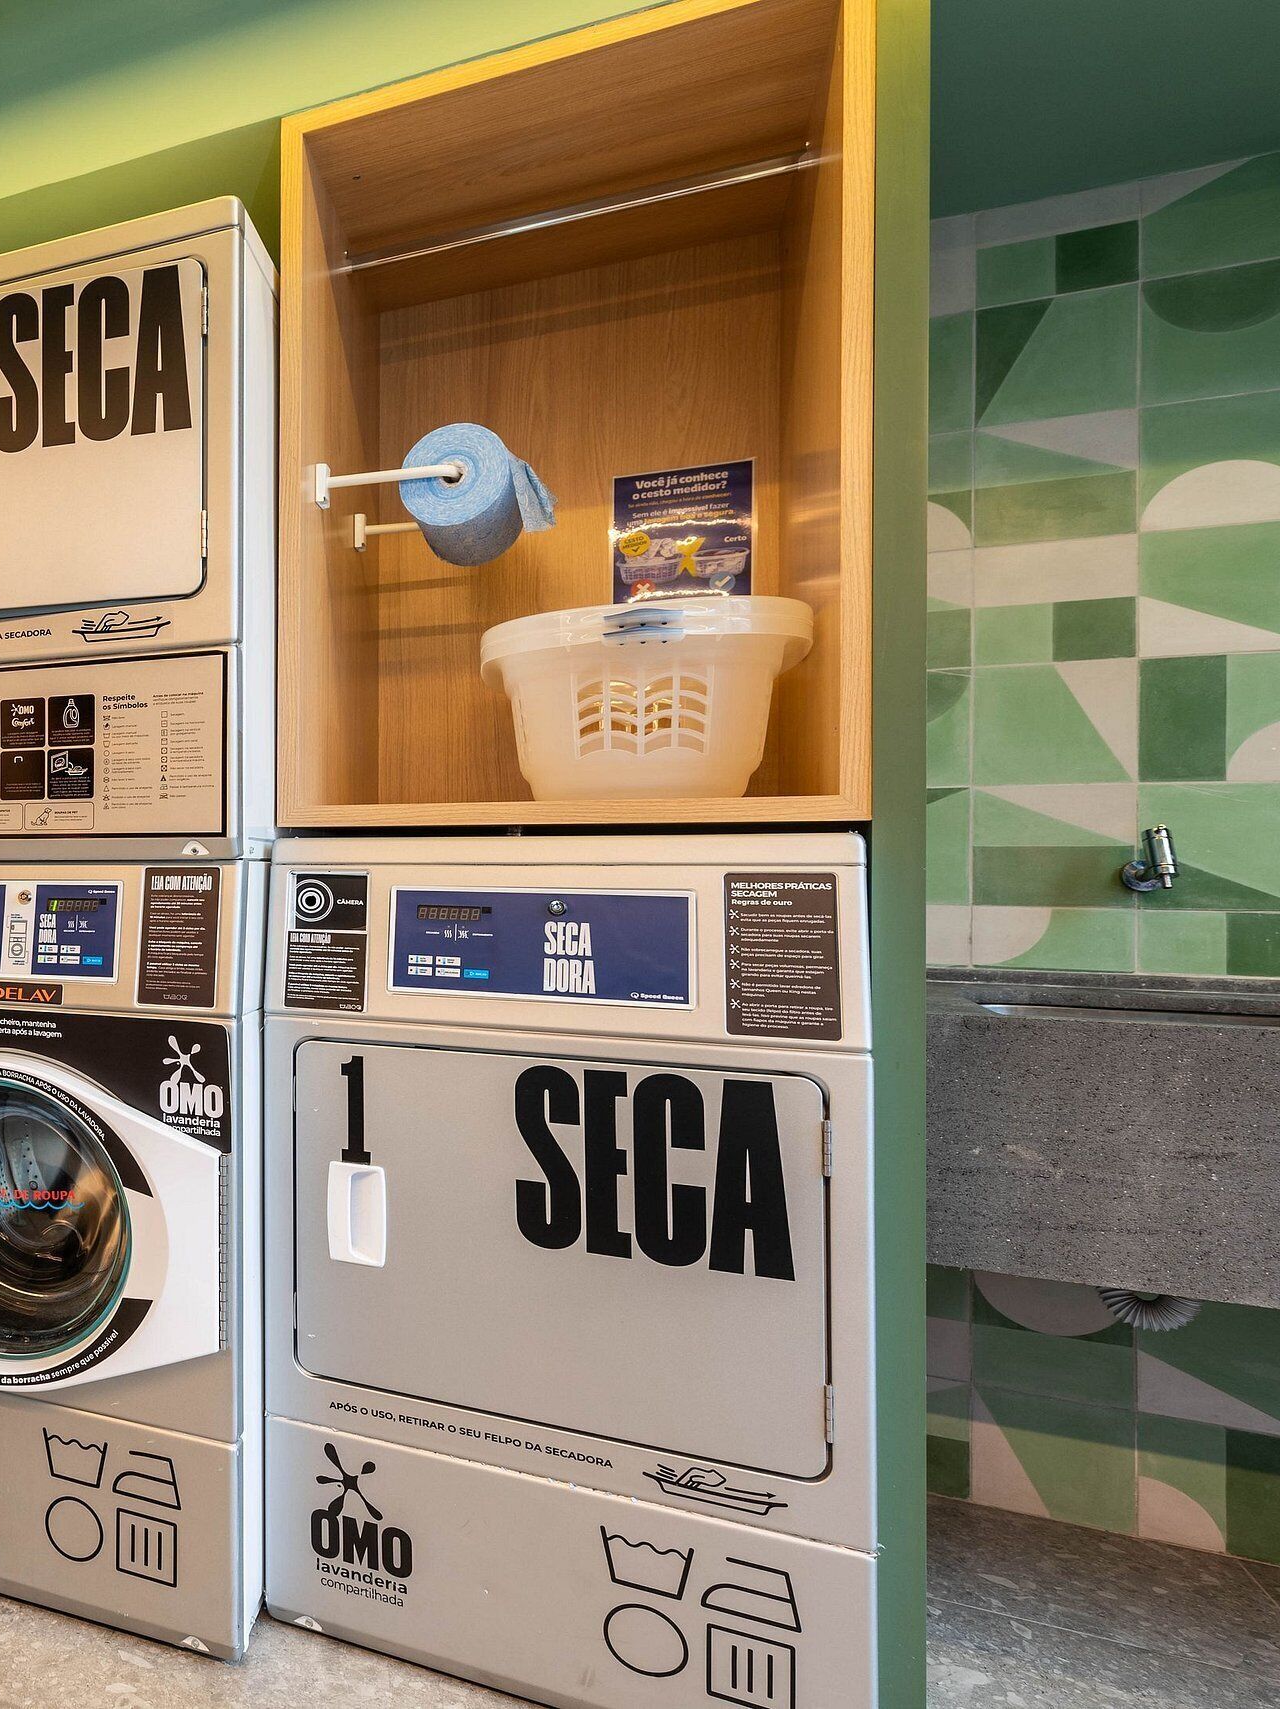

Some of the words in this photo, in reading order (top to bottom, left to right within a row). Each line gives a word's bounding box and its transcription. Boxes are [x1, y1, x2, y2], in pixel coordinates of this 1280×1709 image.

[635, 477, 664, 489] Você
[665, 475, 677, 488] já
[679, 471, 728, 484] conhece
[641, 489, 671, 498] cesto
[673, 481, 727, 495] medidor?
[724, 535, 747, 543] Certo
[5, 629, 51, 640] SECADORA
[103, 694, 136, 702] Respeite
[19, 705, 34, 714] OMO
[151, 876, 163, 890] LEIA
[165, 876, 181, 890] COM
[182, 873, 212, 893] ATENÇÃO
[731, 882, 784, 890] MELHORES
[785, 881, 832, 890] PRÁTICAS
[337, 898, 364, 906] CÂMERA
[731, 890, 777, 898] SECAGEM
[39, 914, 56, 928] SECA
[38, 929, 56, 943] DORA
[544, 921, 592, 956] SECA
[543, 958, 596, 994] DORA
[160, 1080, 223, 1118] OMO
[341, 1055, 371, 1163] 1
[163, 1113, 220, 1128] lavanderia
[514, 1064, 795, 1282] SECA
[14, 1189, 29, 1199] DE
[33, 1190, 75, 1200] ROUPA
[1, 1376, 13, 1384] da
[13, 1373, 50, 1384] borracha
[51, 1362, 79, 1379] sempre
[79, 1354, 94, 1366] que
[93, 1329, 119, 1357] possível
[329, 1401, 357, 1413] APÓS
[360, 1406, 369, 1415] O
[371, 1410, 396, 1422] USO,
[398, 1415, 444, 1431] RETIRAR
[448, 1424, 457, 1433] O
[459, 1427, 481, 1438] SEU
[485, 1432, 521, 1447] FELPO
[525, 1441, 542, 1453] DA
[545, 1446, 613, 1468] SECADORA
[311, 1509, 412, 1578] OMO
[317, 1557, 407, 1594] lavanderia
[321, 1577, 403, 1607] compartilhada
